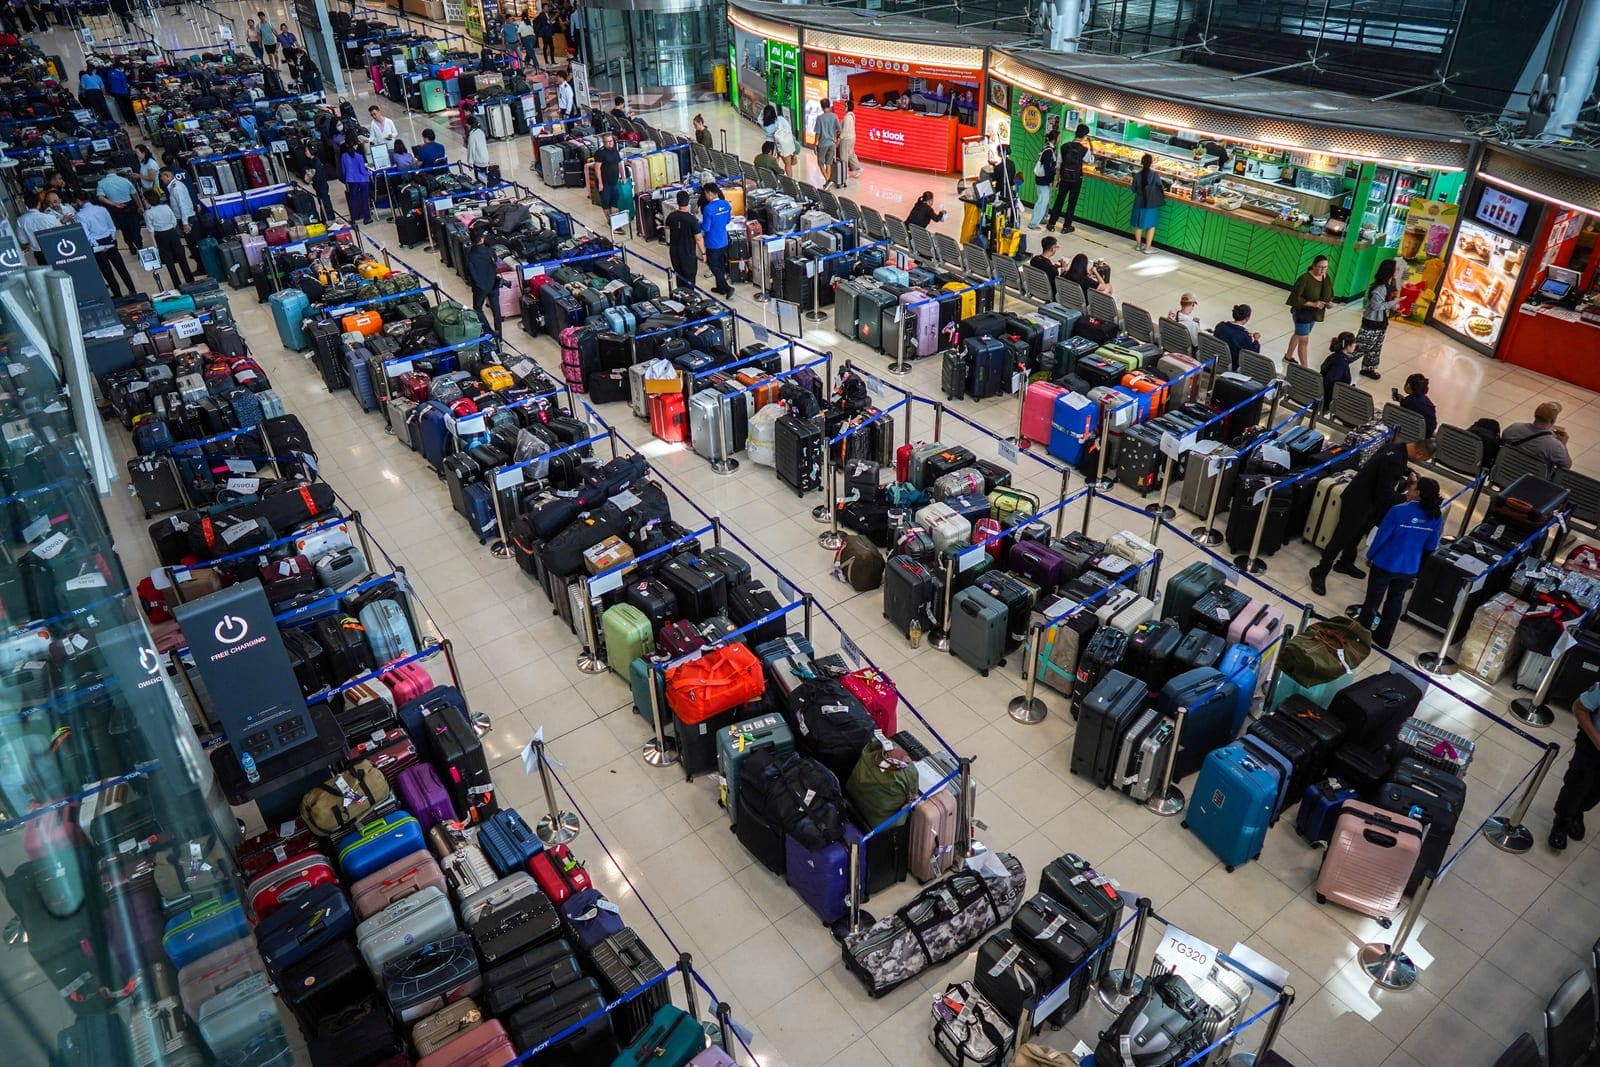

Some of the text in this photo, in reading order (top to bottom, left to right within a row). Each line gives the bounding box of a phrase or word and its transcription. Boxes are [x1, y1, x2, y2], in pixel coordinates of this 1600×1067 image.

[841, 56, 856, 65] klook
[882, 129, 905, 141] klook
[346, 587, 358, 595] AOT
[295, 606, 308, 614] AOT
[757, 616, 768, 625] AOT
[210, 636, 267, 661] FREE CHARGING
[383, 664, 396, 673] AOT
[327, 688, 340, 697] AOT
[1170, 937, 1207, 965] TG320
[605, 998, 622, 1012] AOT
[531, 1040, 549, 1055] AOT
